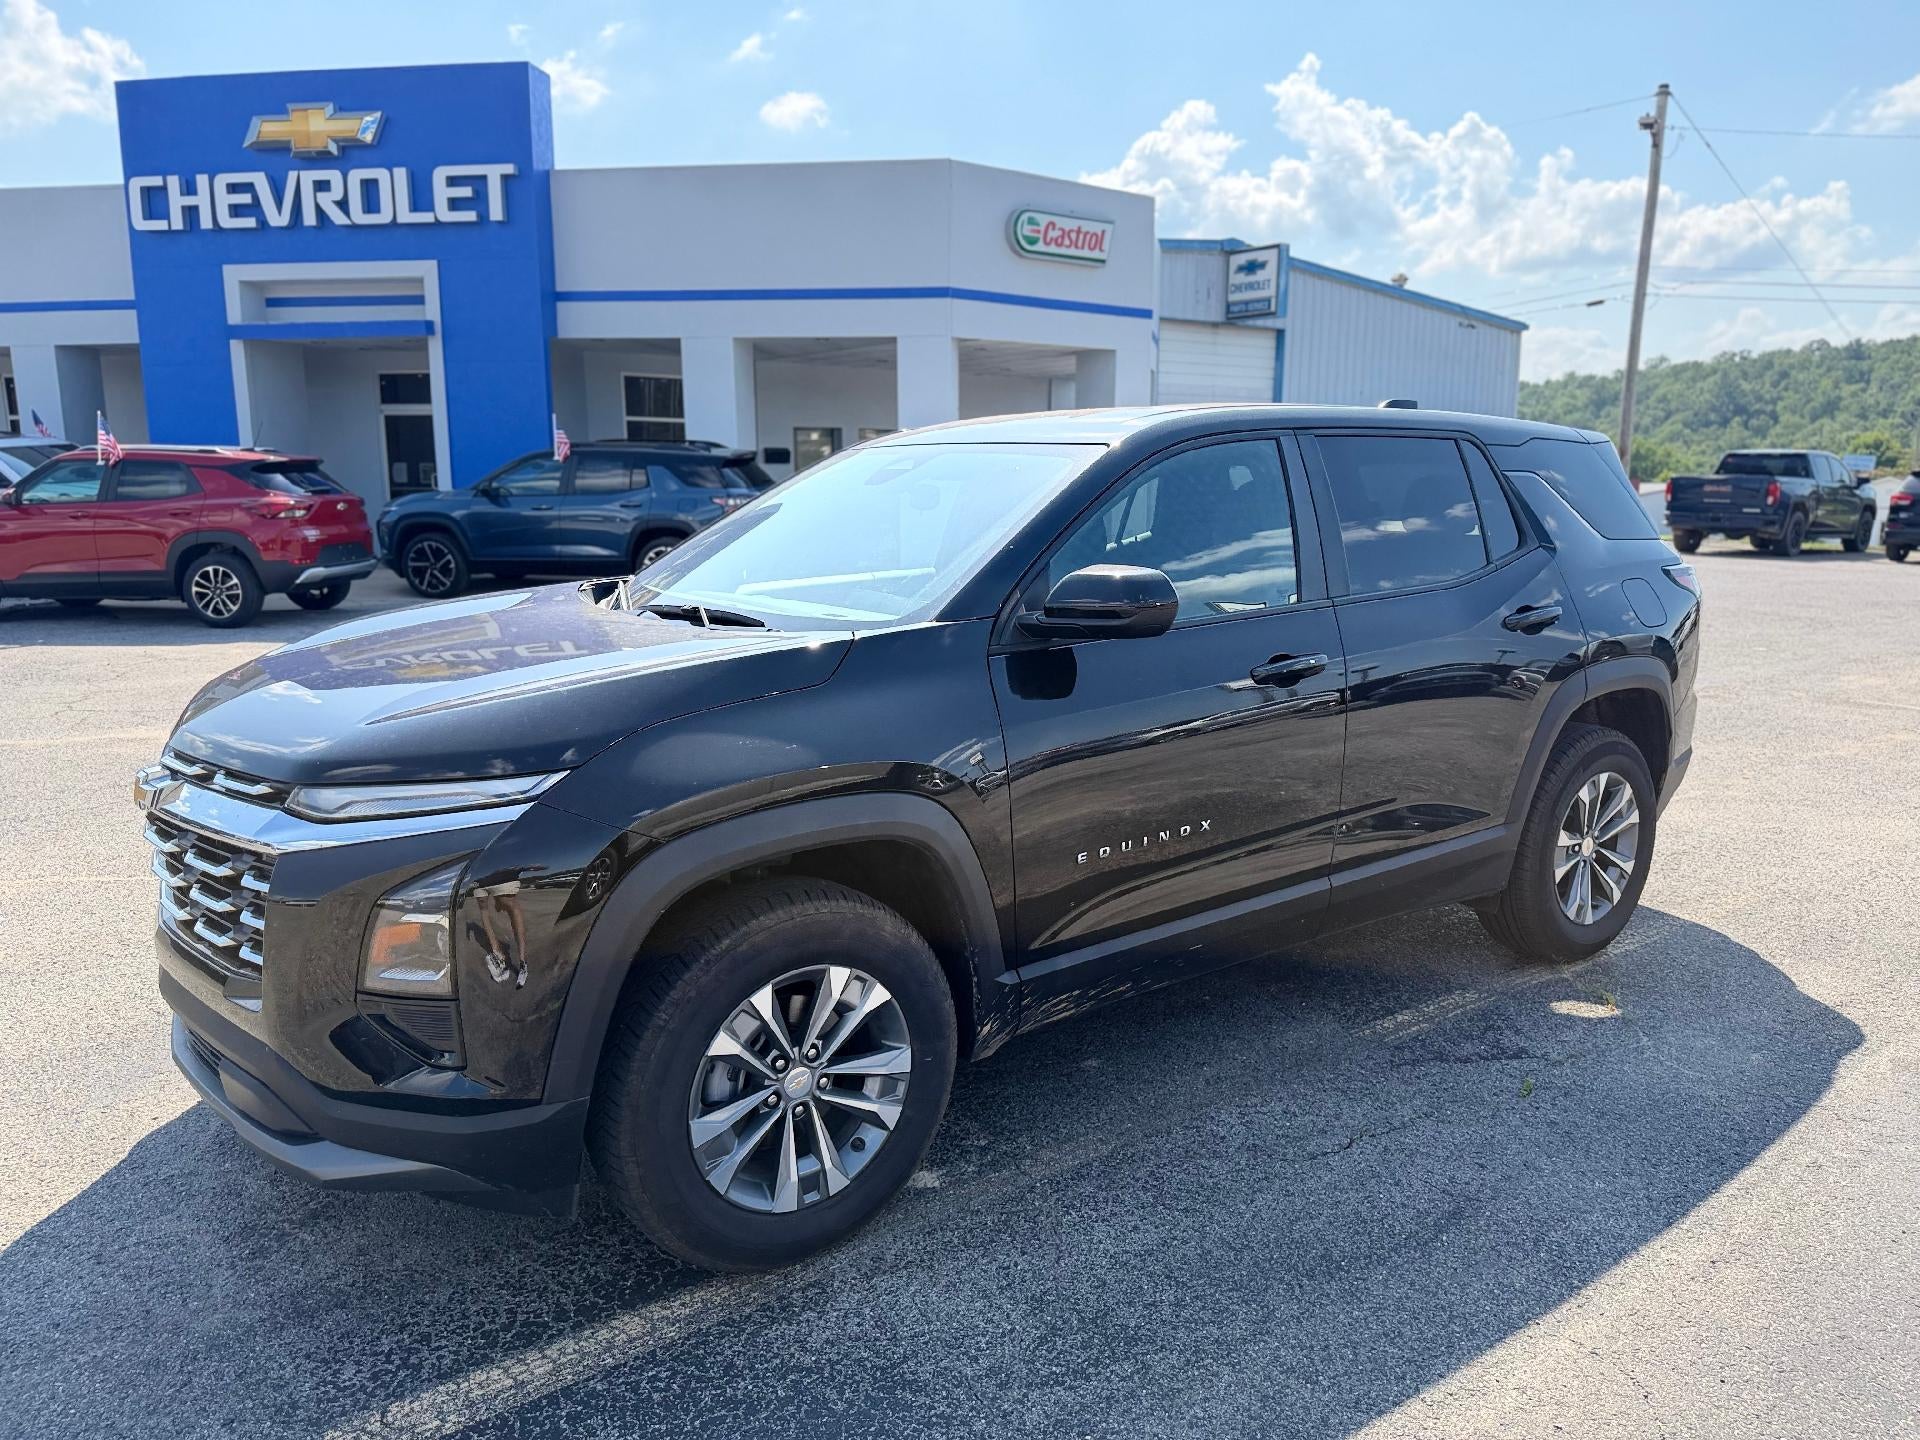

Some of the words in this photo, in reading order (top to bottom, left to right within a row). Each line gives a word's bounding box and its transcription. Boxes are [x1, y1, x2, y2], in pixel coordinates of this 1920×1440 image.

[128, 163, 517, 231] CHEVROLET
[1042, 220, 1106, 253] Castrol
[1229, 278, 1271, 295] CHEVROLET
[1077, 819, 1211, 865] EQUINOX
